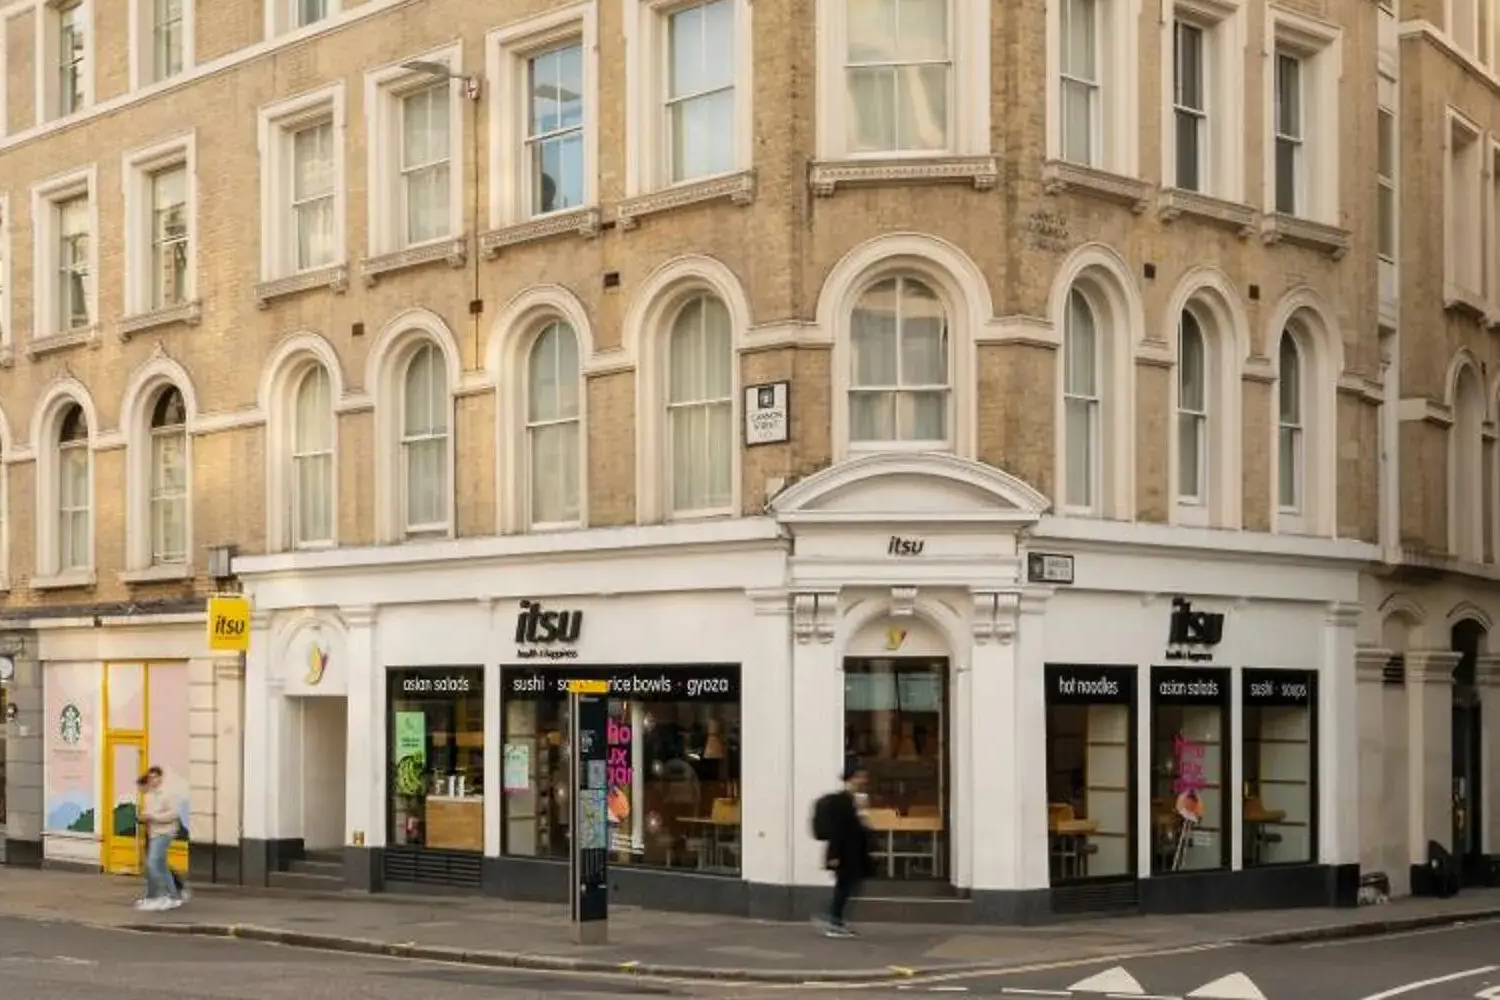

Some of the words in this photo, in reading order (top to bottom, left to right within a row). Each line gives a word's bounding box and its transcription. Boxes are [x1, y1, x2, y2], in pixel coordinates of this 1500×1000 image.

[888, 535, 924, 555] itsu
[215, 615, 245, 635] itsu
[514, 600, 583, 644] itsu
[1168, 597, 1224, 645] itsu
[403, 675, 432, 691] asian
[434, 674, 469, 691] salads
[513, 676, 545, 691] sushi
[633, 676, 671, 692] bowls
[687, 678, 729, 696] gyoza
[1059, 675, 1077, 695] hot
[1078, 675, 1118, 696] noodles
[1159, 681, 1186, 696] asian
[1187, 678, 1219, 696] salads
[1251, 679, 1274, 696] sushi
[1281, 682, 1307, 699] soups
